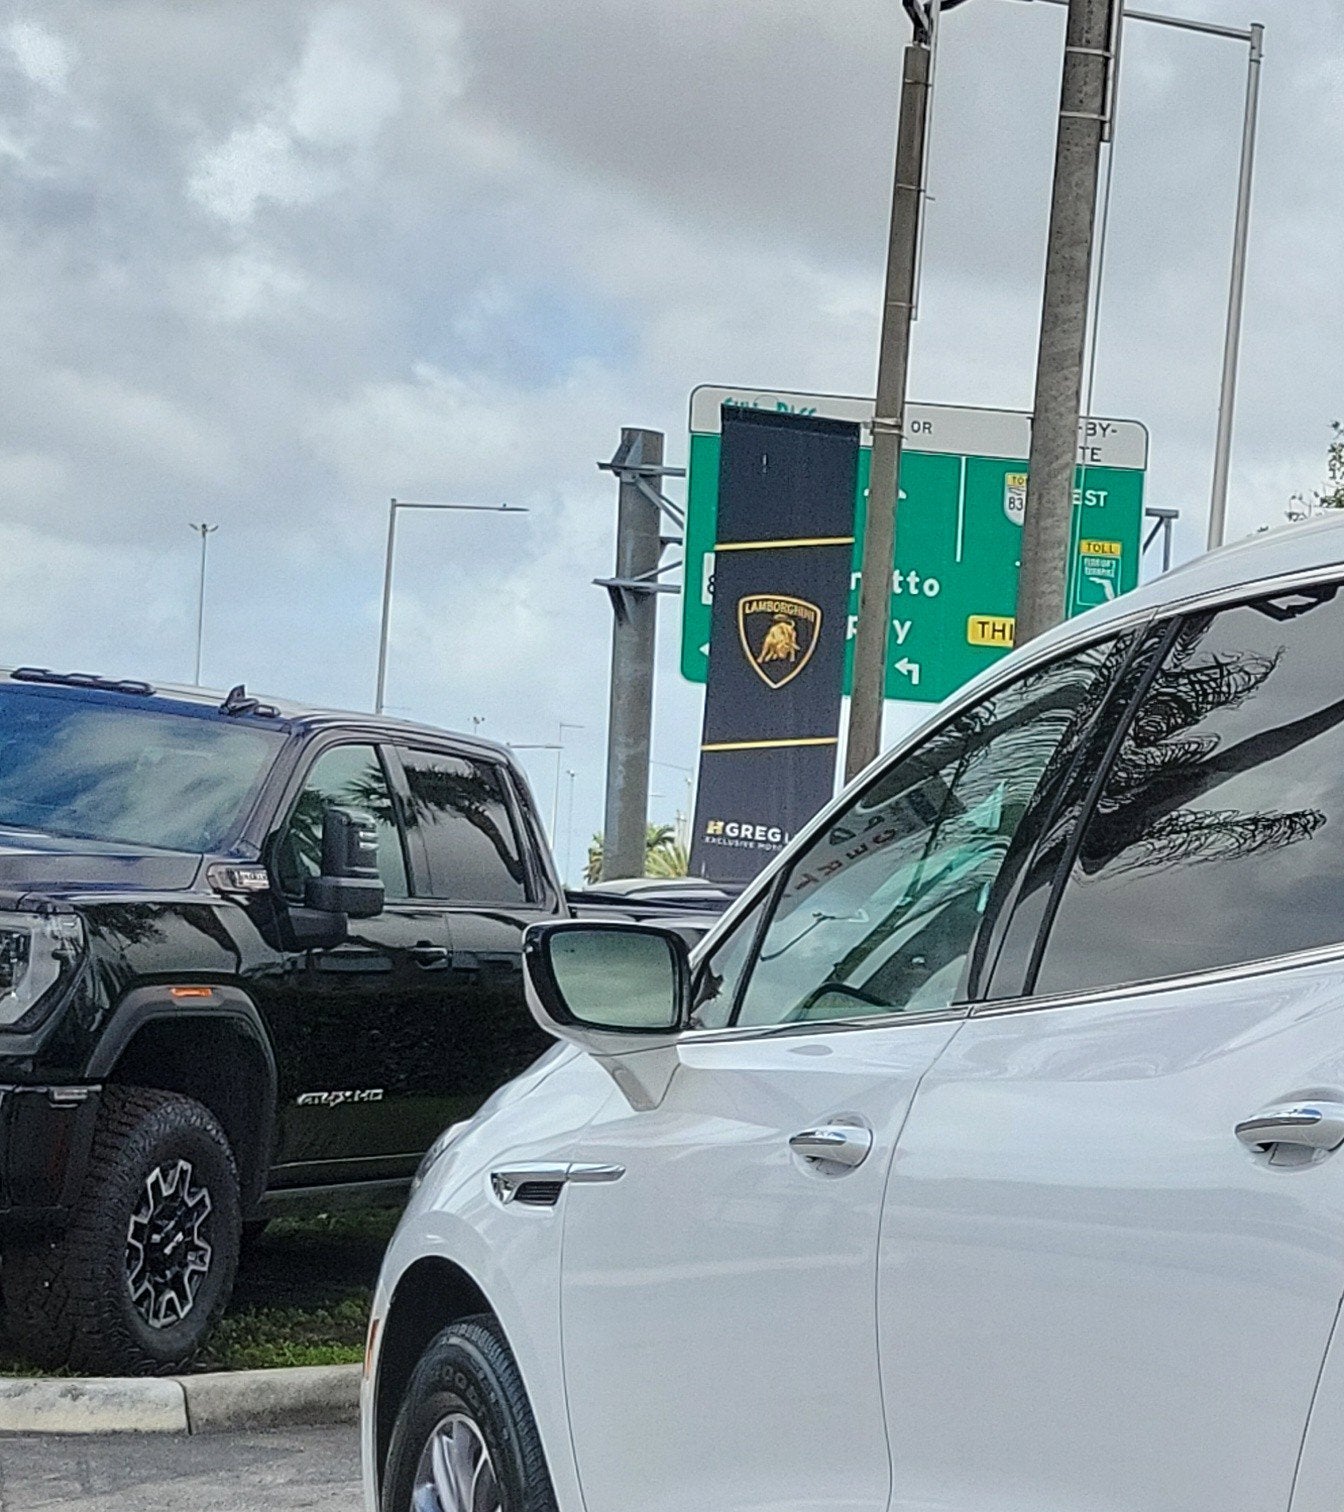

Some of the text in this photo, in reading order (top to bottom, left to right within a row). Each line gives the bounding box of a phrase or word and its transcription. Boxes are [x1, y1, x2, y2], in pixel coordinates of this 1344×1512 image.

[910, 420, 932, 435] OR
[1072, 489, 1109, 507] EST
[1087, 542, 1115, 554] TOLL
[977, 621, 1014, 641] THI
